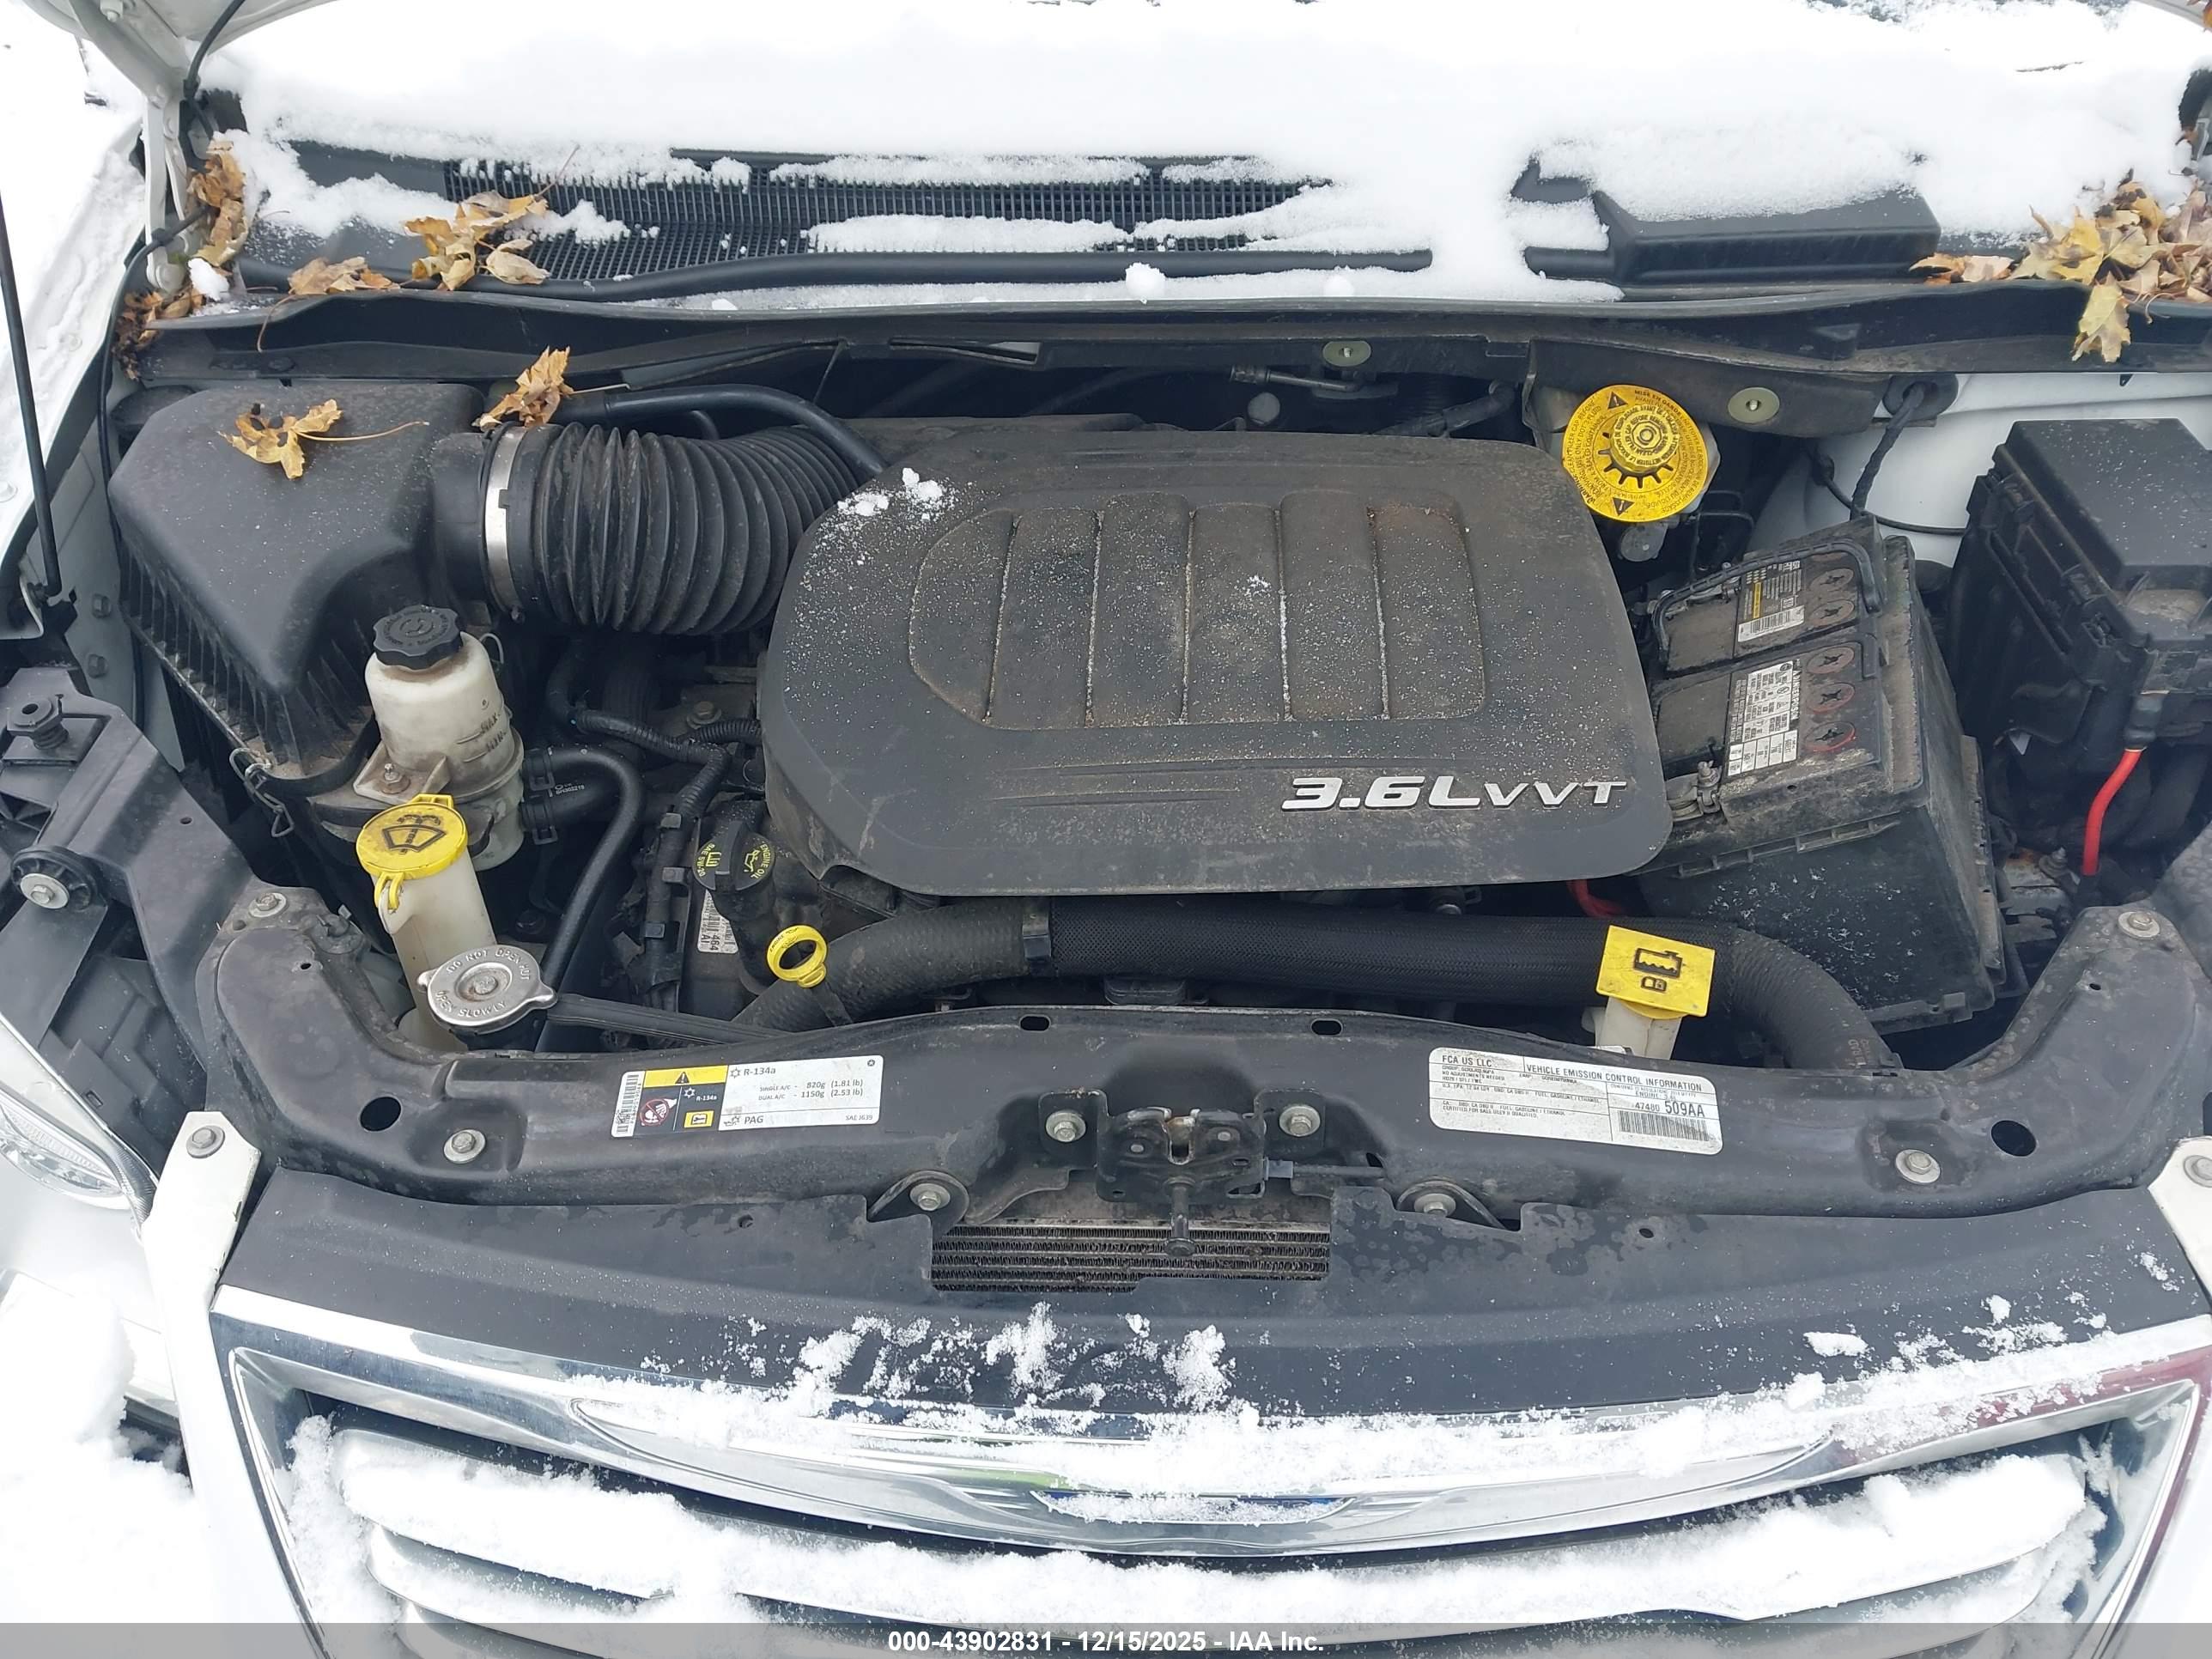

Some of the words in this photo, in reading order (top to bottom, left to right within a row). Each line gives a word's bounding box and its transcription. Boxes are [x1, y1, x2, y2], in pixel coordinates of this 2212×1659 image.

[1483, 781, 1628, 810] VVT
[701, 843, 715, 856] SAE
[759, 843, 771, 869] ENGINE
[750, 868, 765, 879] OIL
[446, 960, 462, 975] DO
[466, 949, 489, 962] NOT
[494, 947, 523, 965] OPEN
[457, 1000, 507, 1018] SLOWLY
[1442, 1055, 1458, 1064] FCA
[1462, 1057, 1473, 1065] US
[1477, 1058, 1492, 1067] LLC
[744, 1067, 776, 1076] R-134a
[1527, 1064, 1560, 1076] VEHICLE
[1563, 1068, 1602, 1080] EMISSION
[1605, 1073, 1641, 1085] CONTROL
[1646, 1078, 1702, 1092] INFORMATION
[807, 1082, 825, 1090] 820g
[831, 1080, 851, 1088] (1.81
[801, 1090, 825, 1099] 1150g
[830, 1089, 851, 1097] (2.53
[1635, 1102, 1661, 1112] 47480
[1665, 1100, 1705, 1117] 509AA
[744, 1115, 764, 1125] PAG
